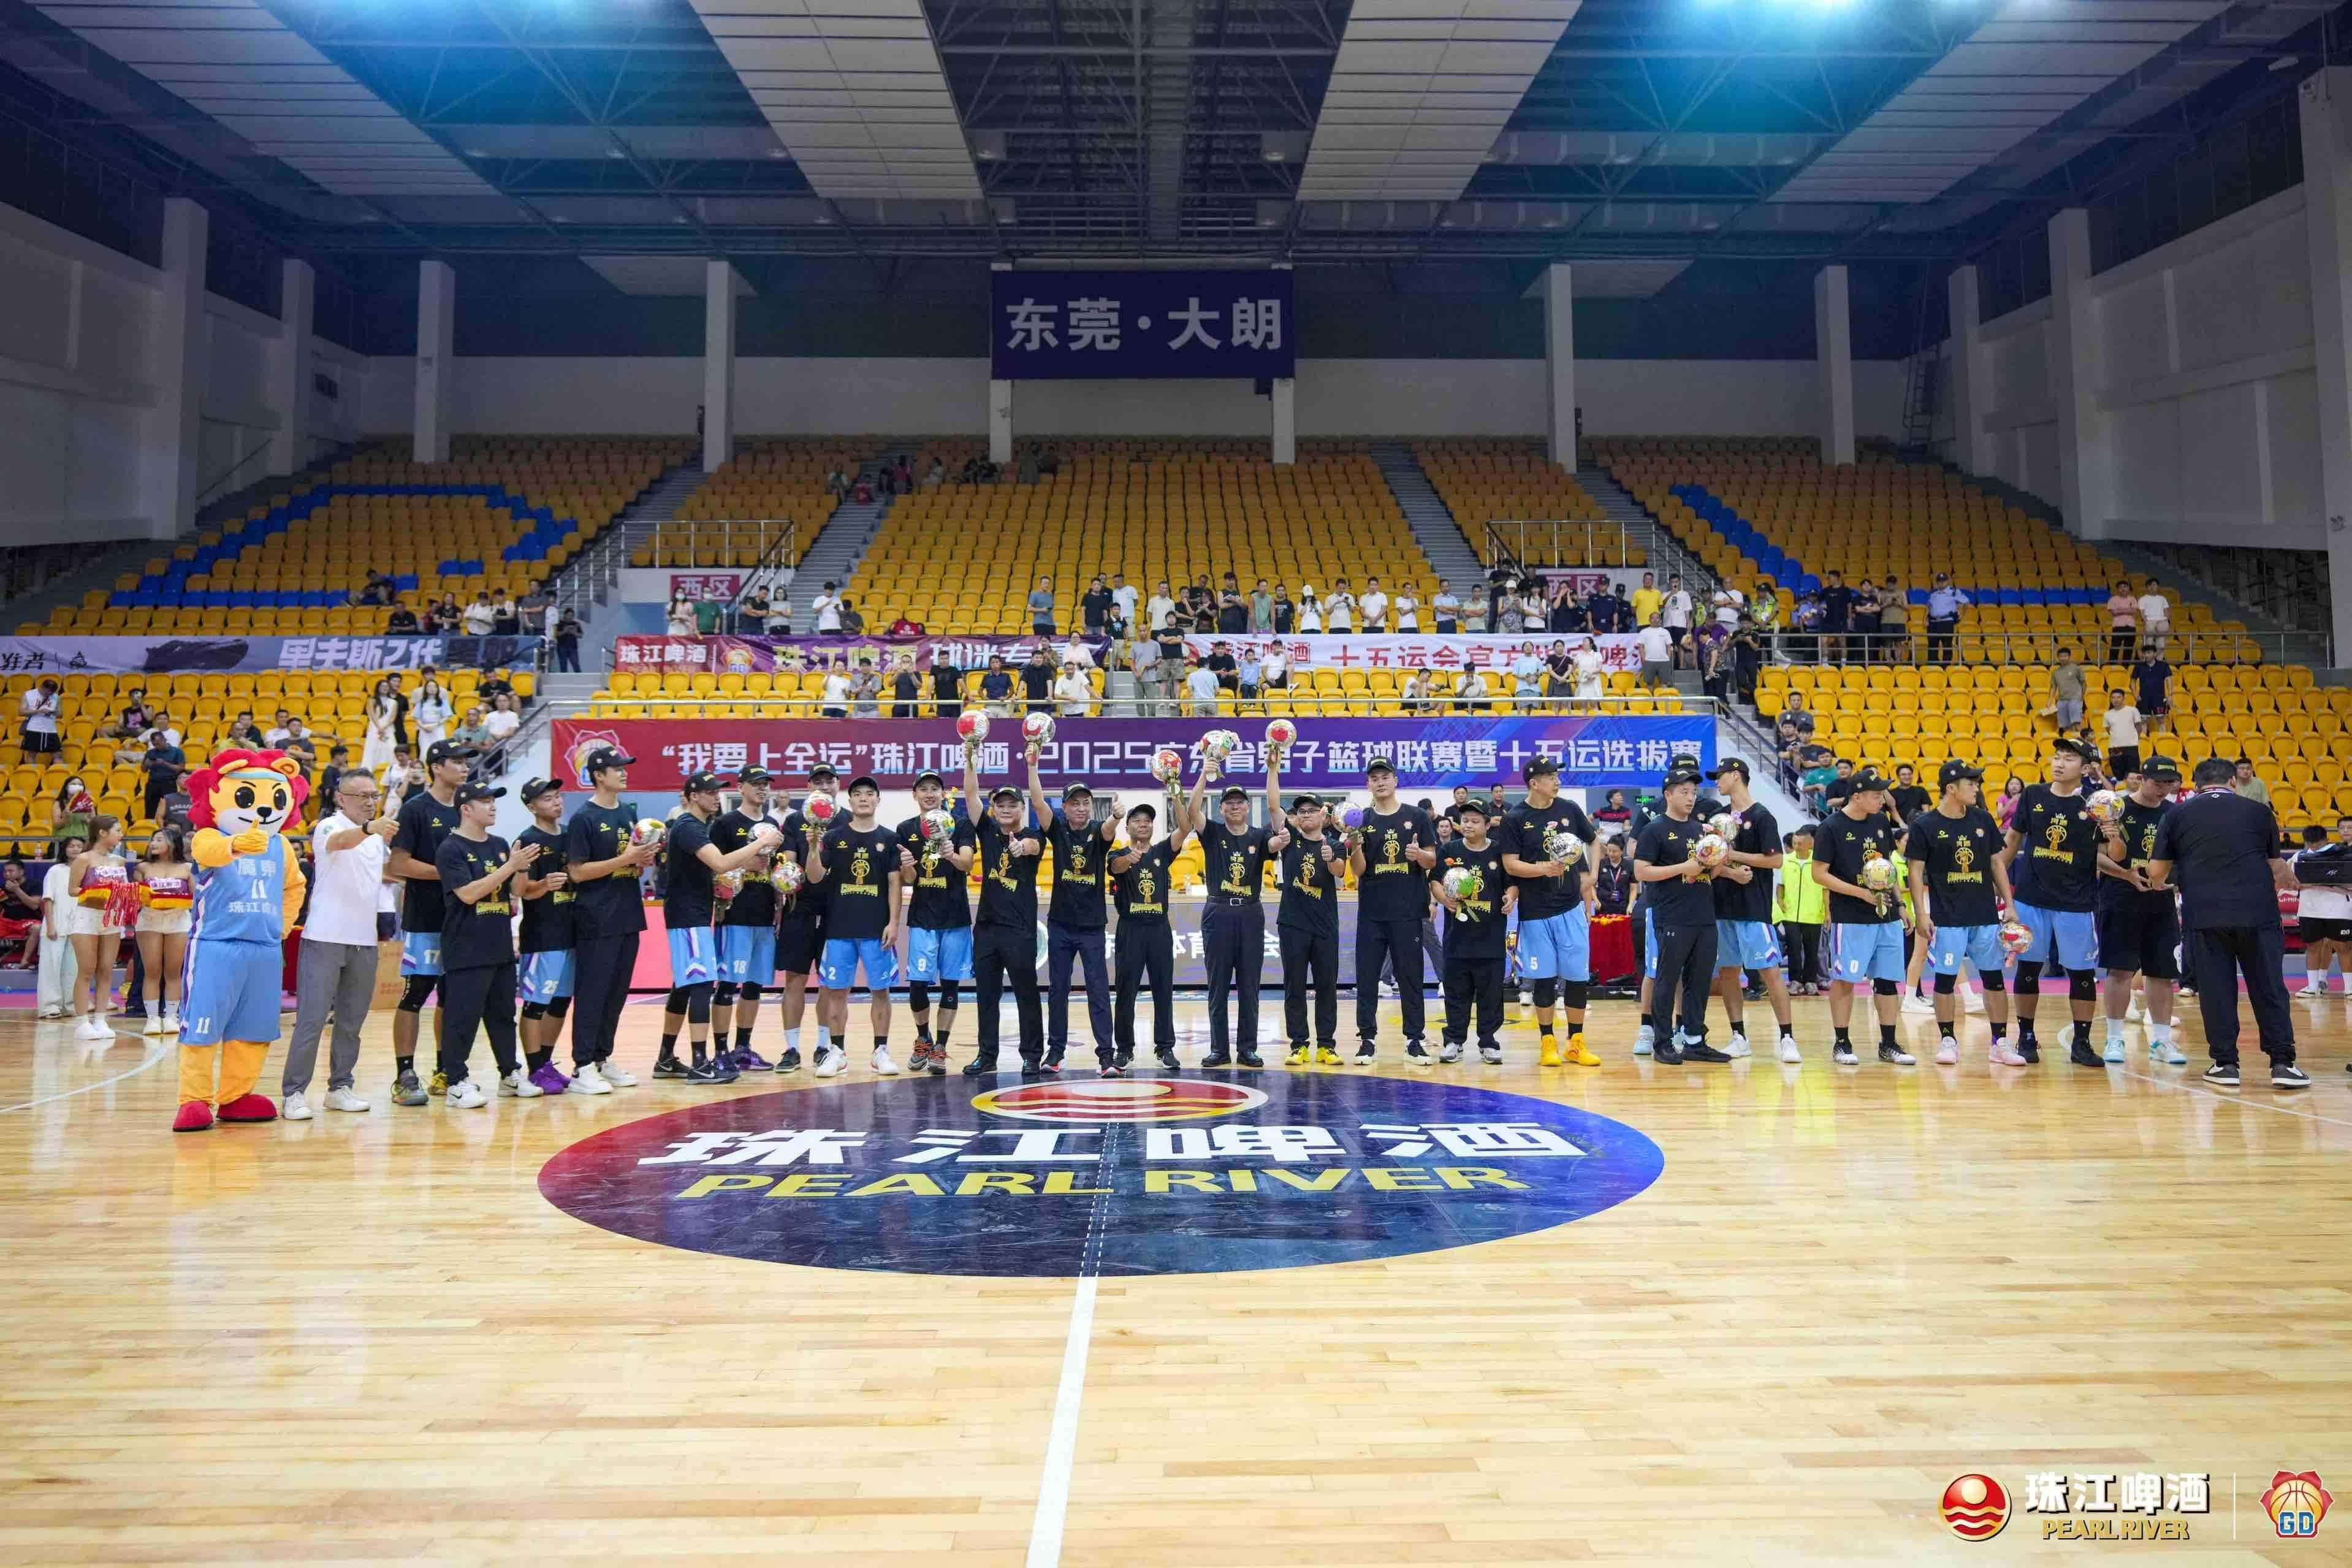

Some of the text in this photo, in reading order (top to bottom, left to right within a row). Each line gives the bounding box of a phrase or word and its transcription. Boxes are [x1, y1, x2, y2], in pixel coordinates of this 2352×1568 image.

[1007, 297, 1282, 351] 东莞·大朗
[619, 644, 707, 663] 珠江啤酒
[1530, 957, 1538, 970] 5
[1944, 952, 1954, 966] 8
[828, 967, 836, 980] 2
[195, 1017, 211, 1035] 11
[637, 1123, 1588, 1165] 珠江啤酒
[676, 1167, 1532, 1198] PEARL RIVER
